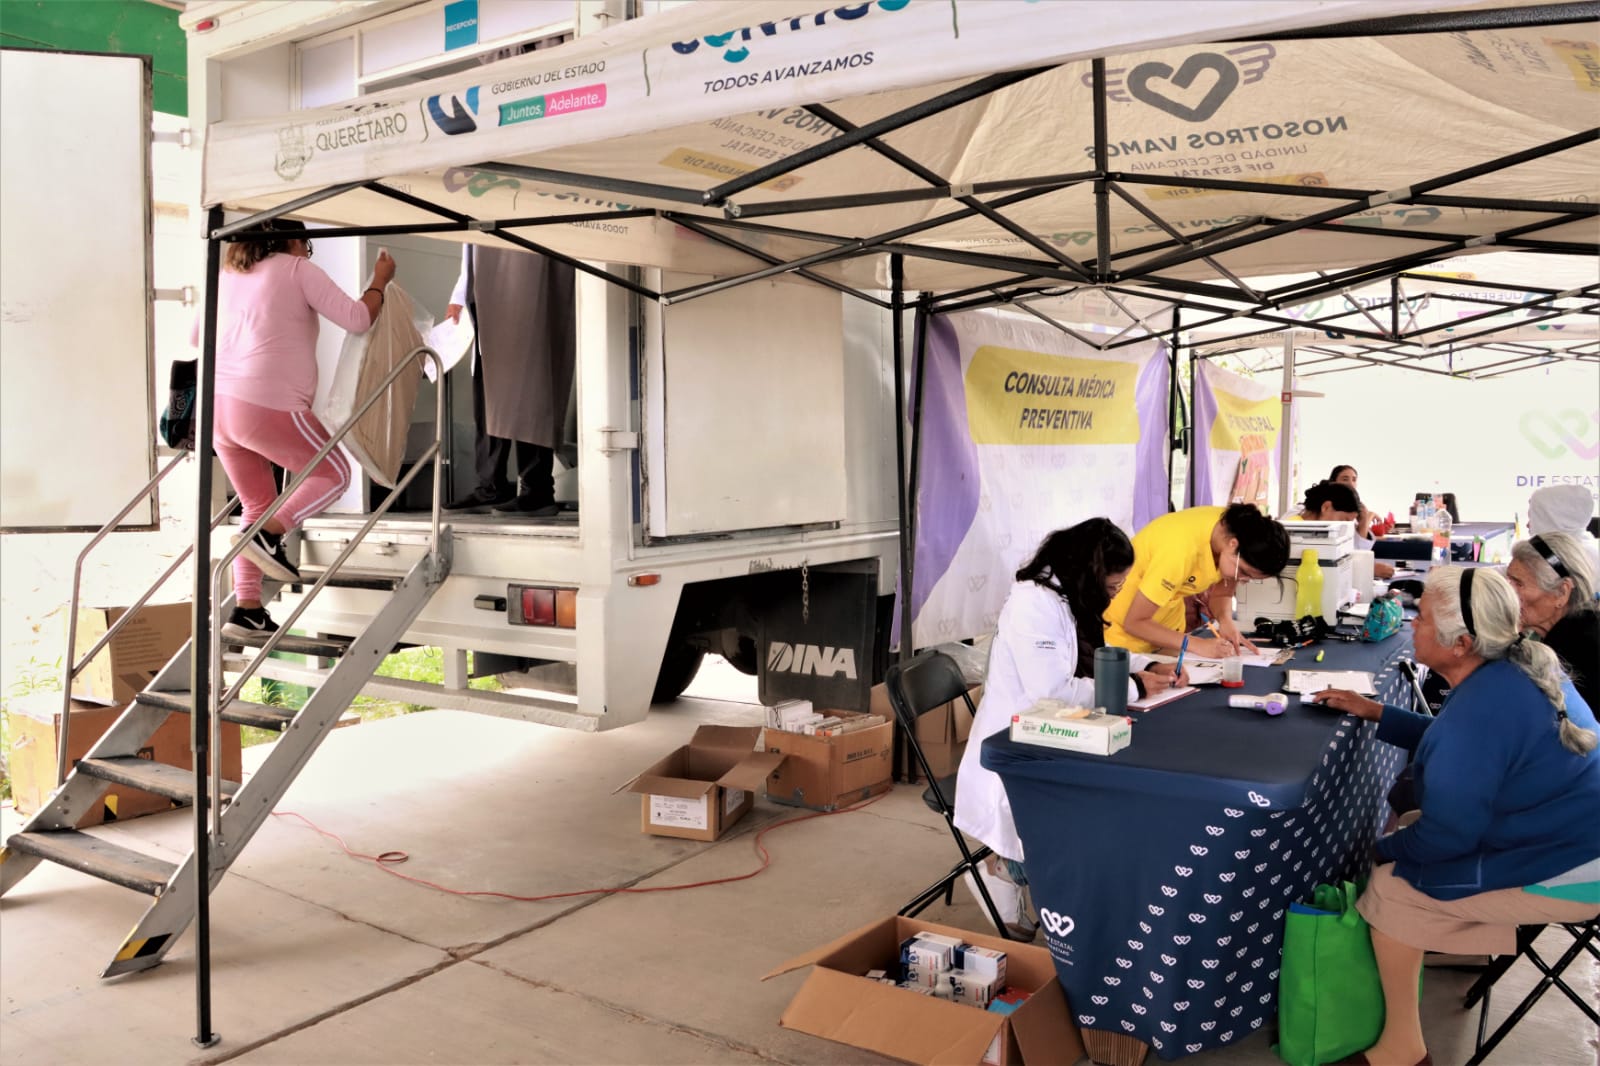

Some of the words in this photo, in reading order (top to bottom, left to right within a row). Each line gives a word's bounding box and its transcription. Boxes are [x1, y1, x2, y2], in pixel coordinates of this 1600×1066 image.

[491, 74, 541, 95] GOBIERNO
[543, 71, 562, 83] DEL
[565, 60, 606, 79] ESTADO
[703, 73, 758, 94] TODOS
[761, 51, 874, 84] AVANZAMOS
[507, 103, 543, 121] Juntos,
[549, 92, 602, 113] Adelante.
[315, 112, 408, 152] QUERÉTARO
[1004, 371, 1074, 397] CONSULTA
[1076, 374, 1116, 399] MÉDICA
[1019, 408, 1093, 430] PREVENTIVA
[1516, 475, 1546, 487] DIF
[767, 641, 858, 680] DINA
